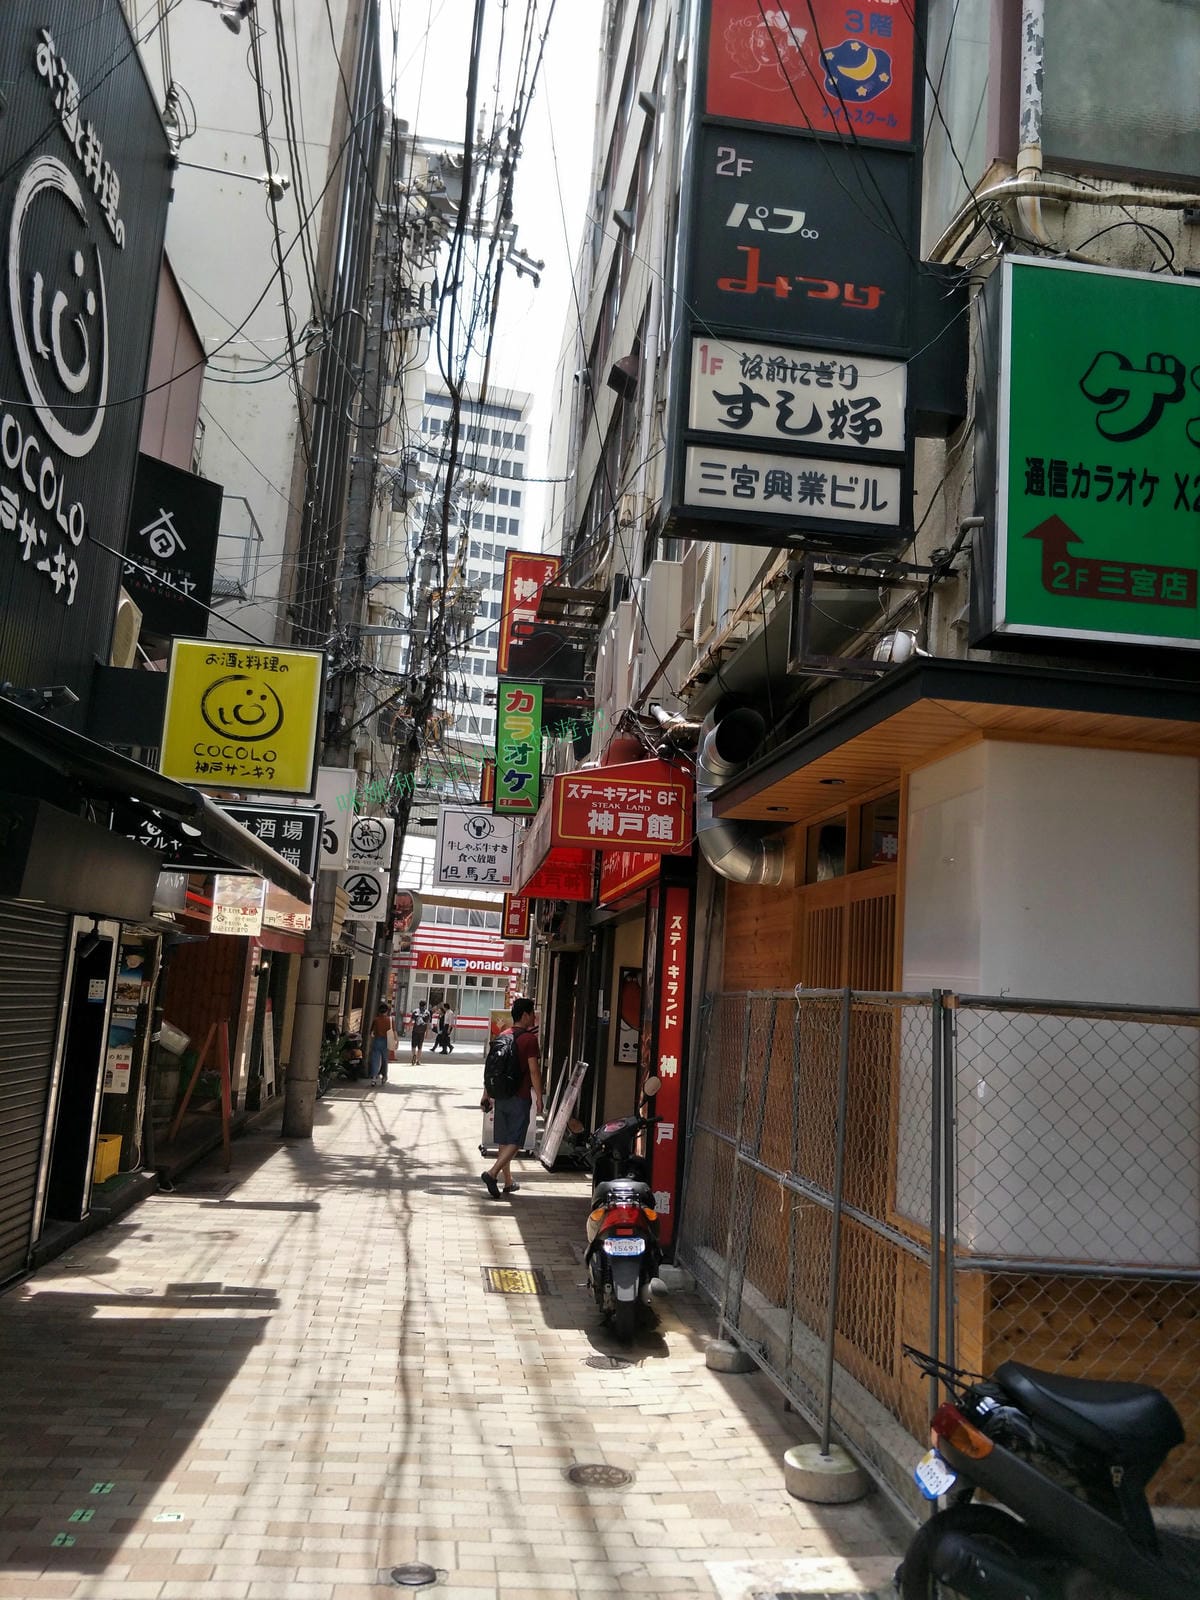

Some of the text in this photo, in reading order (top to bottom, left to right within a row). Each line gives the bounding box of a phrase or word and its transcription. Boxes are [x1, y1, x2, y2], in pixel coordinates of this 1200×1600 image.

[844, 9, 893, 38] 3階
[36, 27, 126, 250] お酒と料理の
[716, 146, 753, 177] 2F
[700, 345, 724, 376] 1F
[739, 352, 859, 391] 板前にぎり
[712, 381, 884, 445] すし好
[699, 462, 888, 511] 三宮興業ビル
[1024, 456, 1160, 507] 通信カラオケ
[1051, 561, 1188, 601] 2F 三宮店
[509, 577, 538, 646] 神戸
[205, 652, 289, 673] お酒と料理の
[193, 742, 277, 762] COCOLO
[503, 690, 535, 793] カラオケ
[195, 761, 275, 780] 神戸サンキタ
[567, 783, 678, 806] ステーキランド 6F
[591, 801, 651, 812] STEAK LAND
[587, 809, 673, 840] 神戸館
[442, 865, 501, 882] 但馬屋
[458, 853, 497, 865] 食べ放題
[348, 876, 378, 907] 金
[666, 915, 682, 1029] ステーキランド
